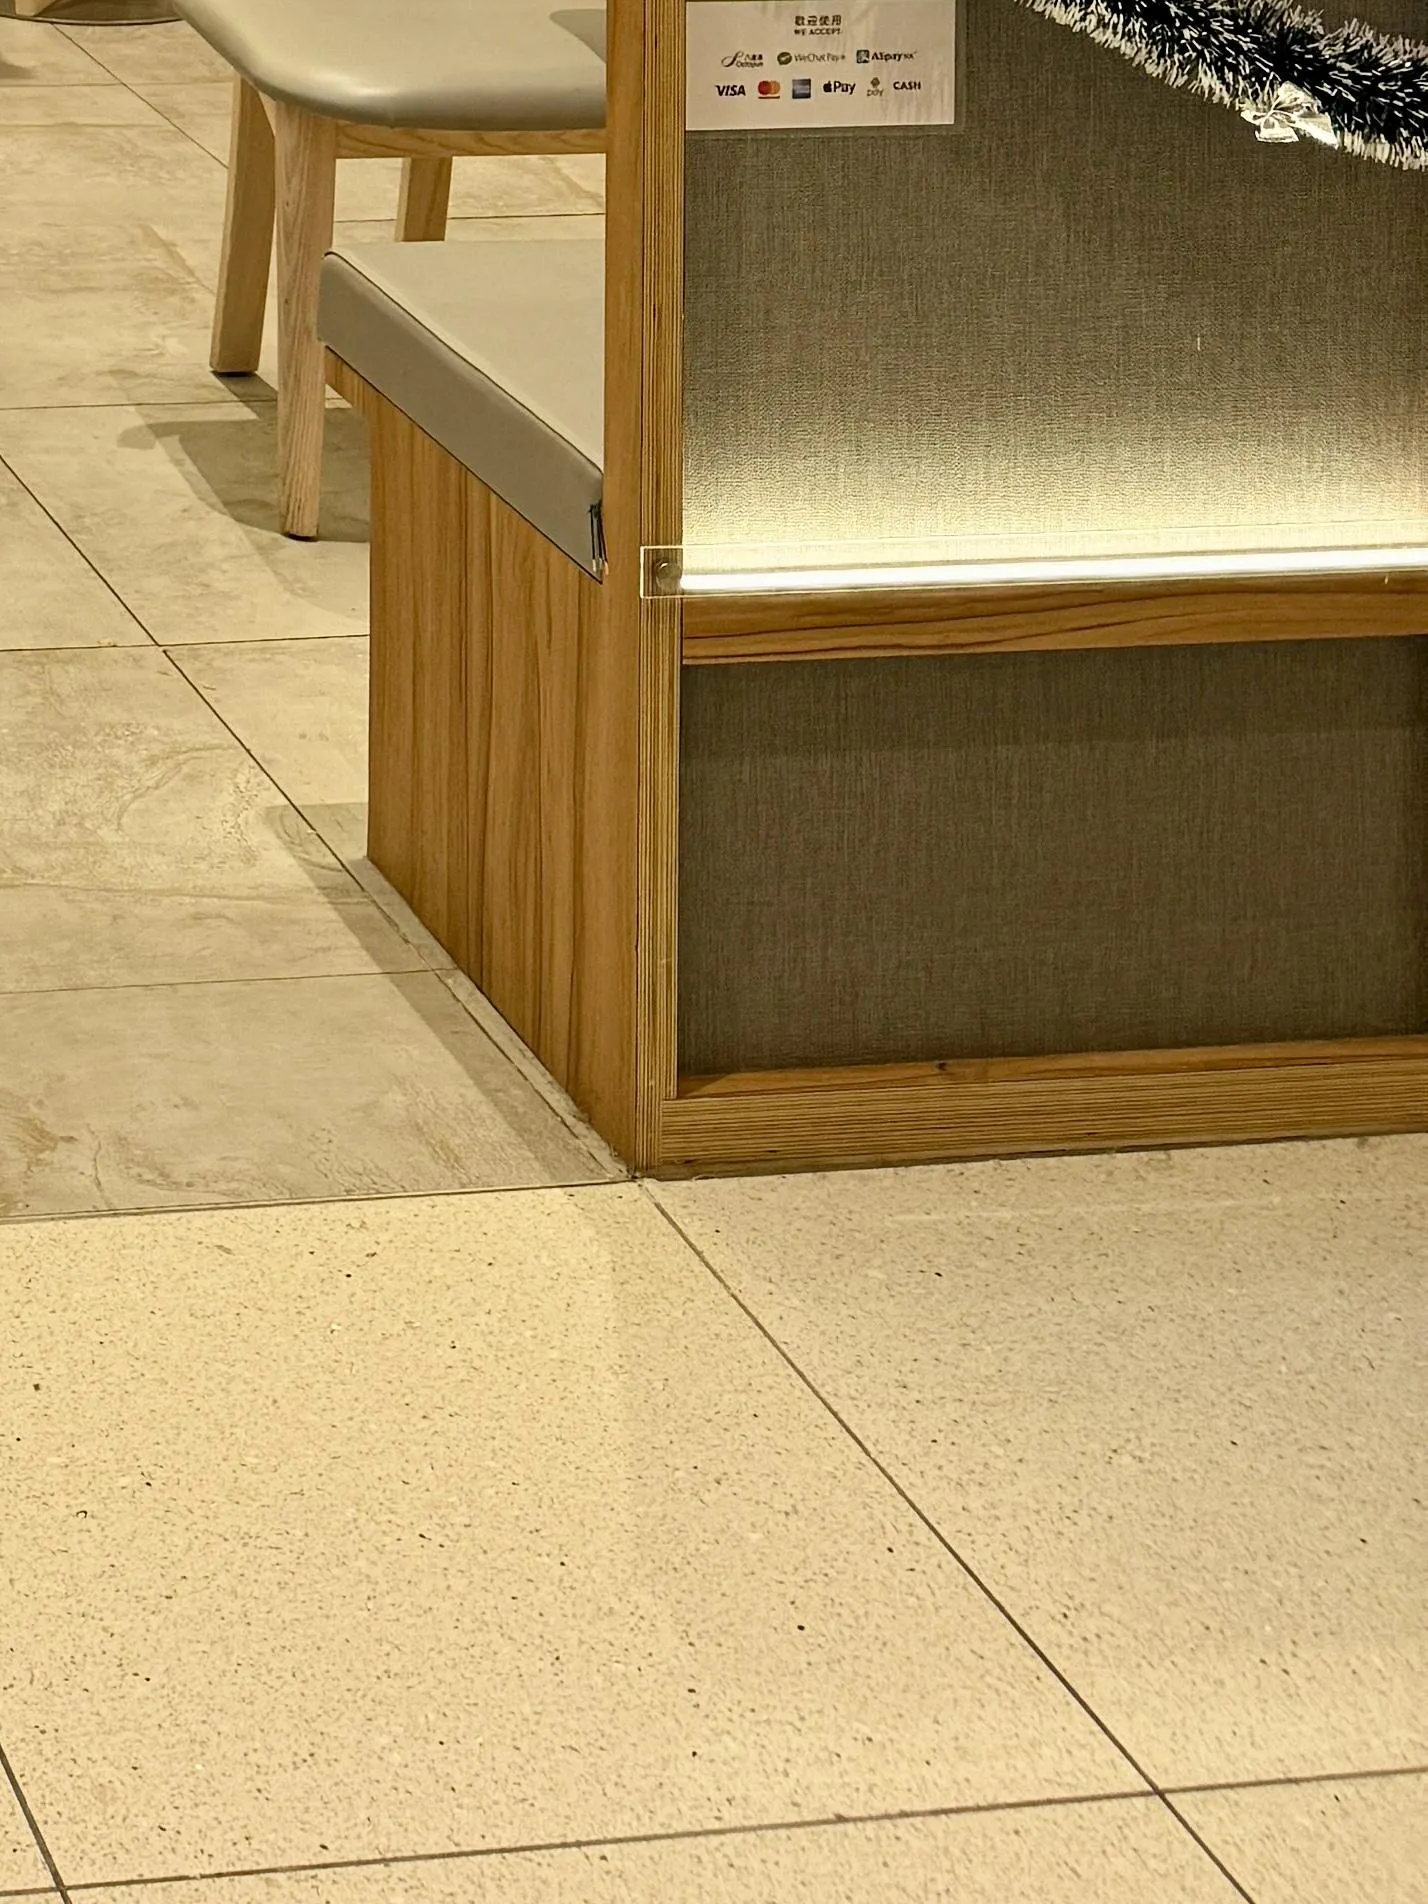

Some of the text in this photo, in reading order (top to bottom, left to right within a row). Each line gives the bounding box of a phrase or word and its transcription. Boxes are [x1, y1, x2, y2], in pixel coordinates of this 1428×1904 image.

[715, 84, 746, 97] VISA
[834, 80, 856, 95] Pay
[892, 80, 922, 91] CASH
